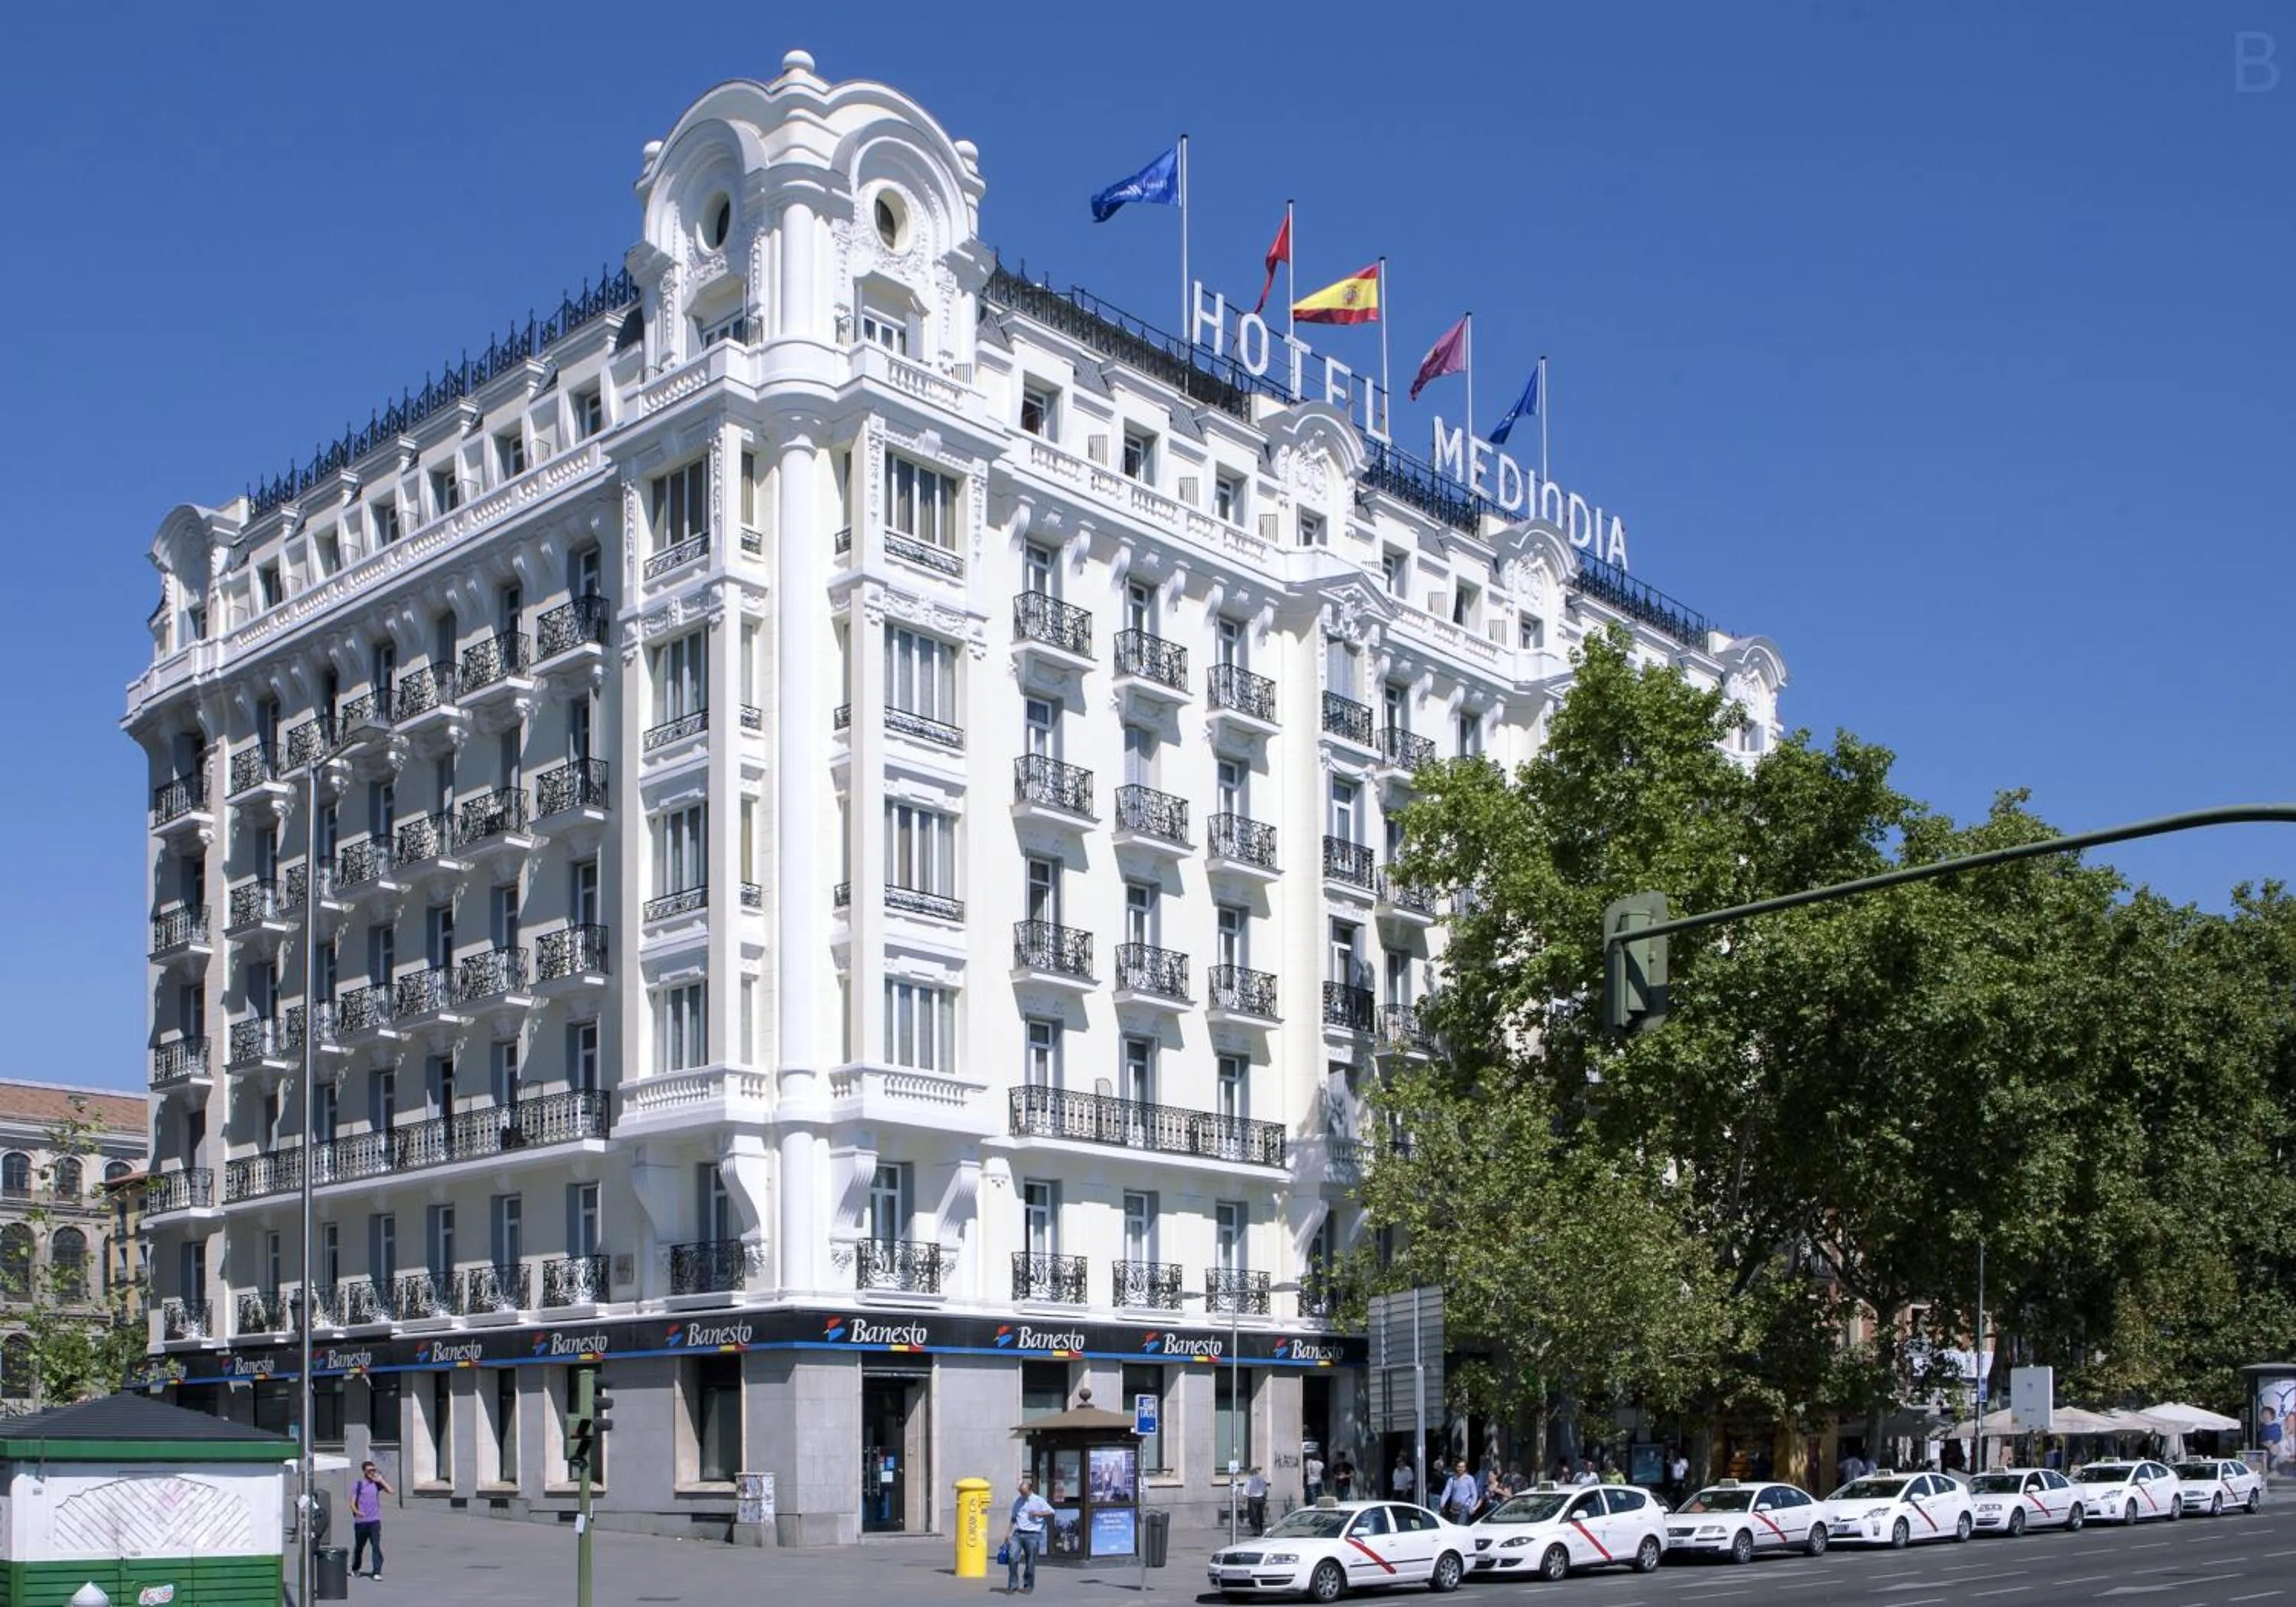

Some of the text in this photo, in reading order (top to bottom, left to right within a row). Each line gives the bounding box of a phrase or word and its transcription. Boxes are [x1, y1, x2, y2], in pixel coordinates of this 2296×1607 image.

[1192, 280, 1628, 571] HOTEL MEDIODIA
[550, 1331, 608, 1354] Banesto
[687, 1319, 752, 1345] Banesto
[850, 1319, 927, 1346] Banesto
[1017, 1328, 1084, 1352] Banesto
[432, 1339, 482, 1364] Banesto
[1163, 1332, 1222, 1358] Banesto
[1292, 1338, 1344, 1362] Banesto
[235, 1354, 275, 1376] Banesto
[328, 1347, 372, 1370] Banesto
